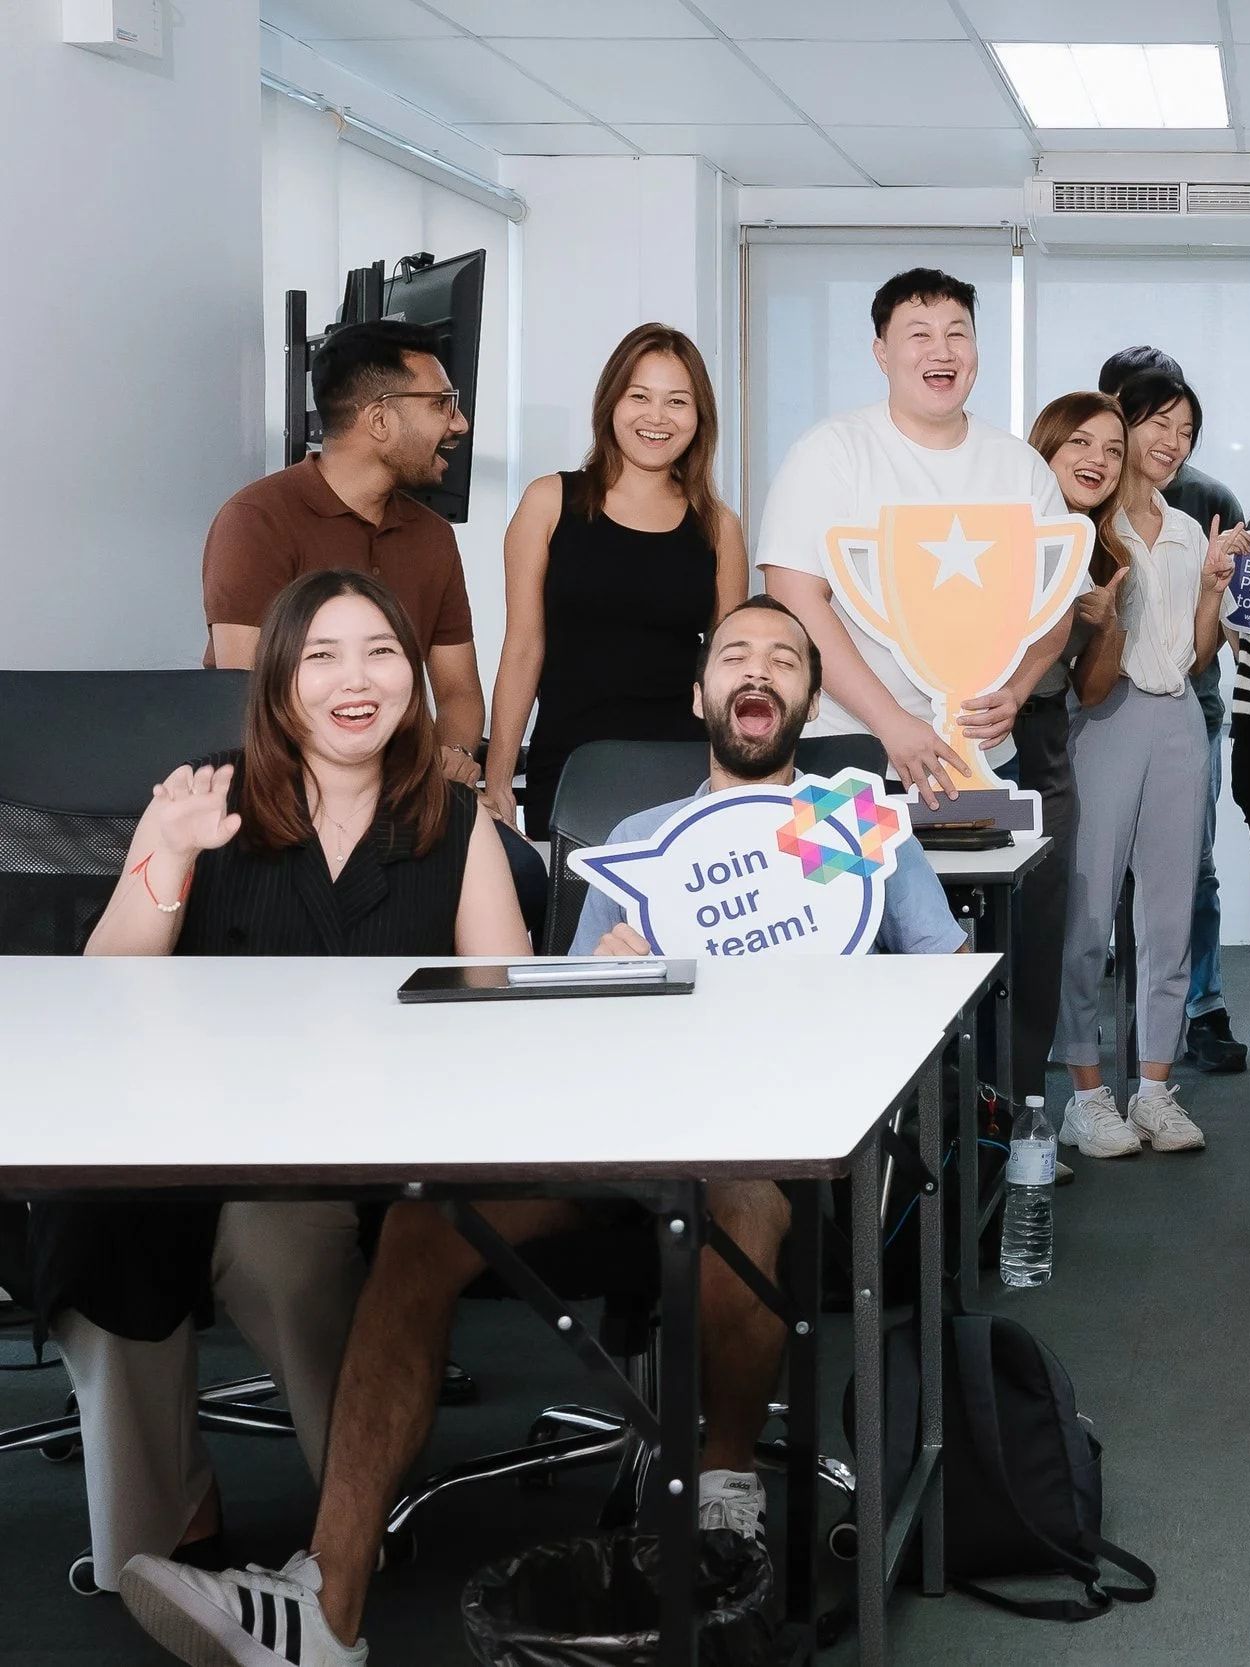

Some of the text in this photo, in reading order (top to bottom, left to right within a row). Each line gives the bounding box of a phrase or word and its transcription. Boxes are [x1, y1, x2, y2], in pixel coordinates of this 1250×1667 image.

[684, 849, 769, 893] Join
[696, 887, 760, 929] our
[705, 905, 819, 956] team!
